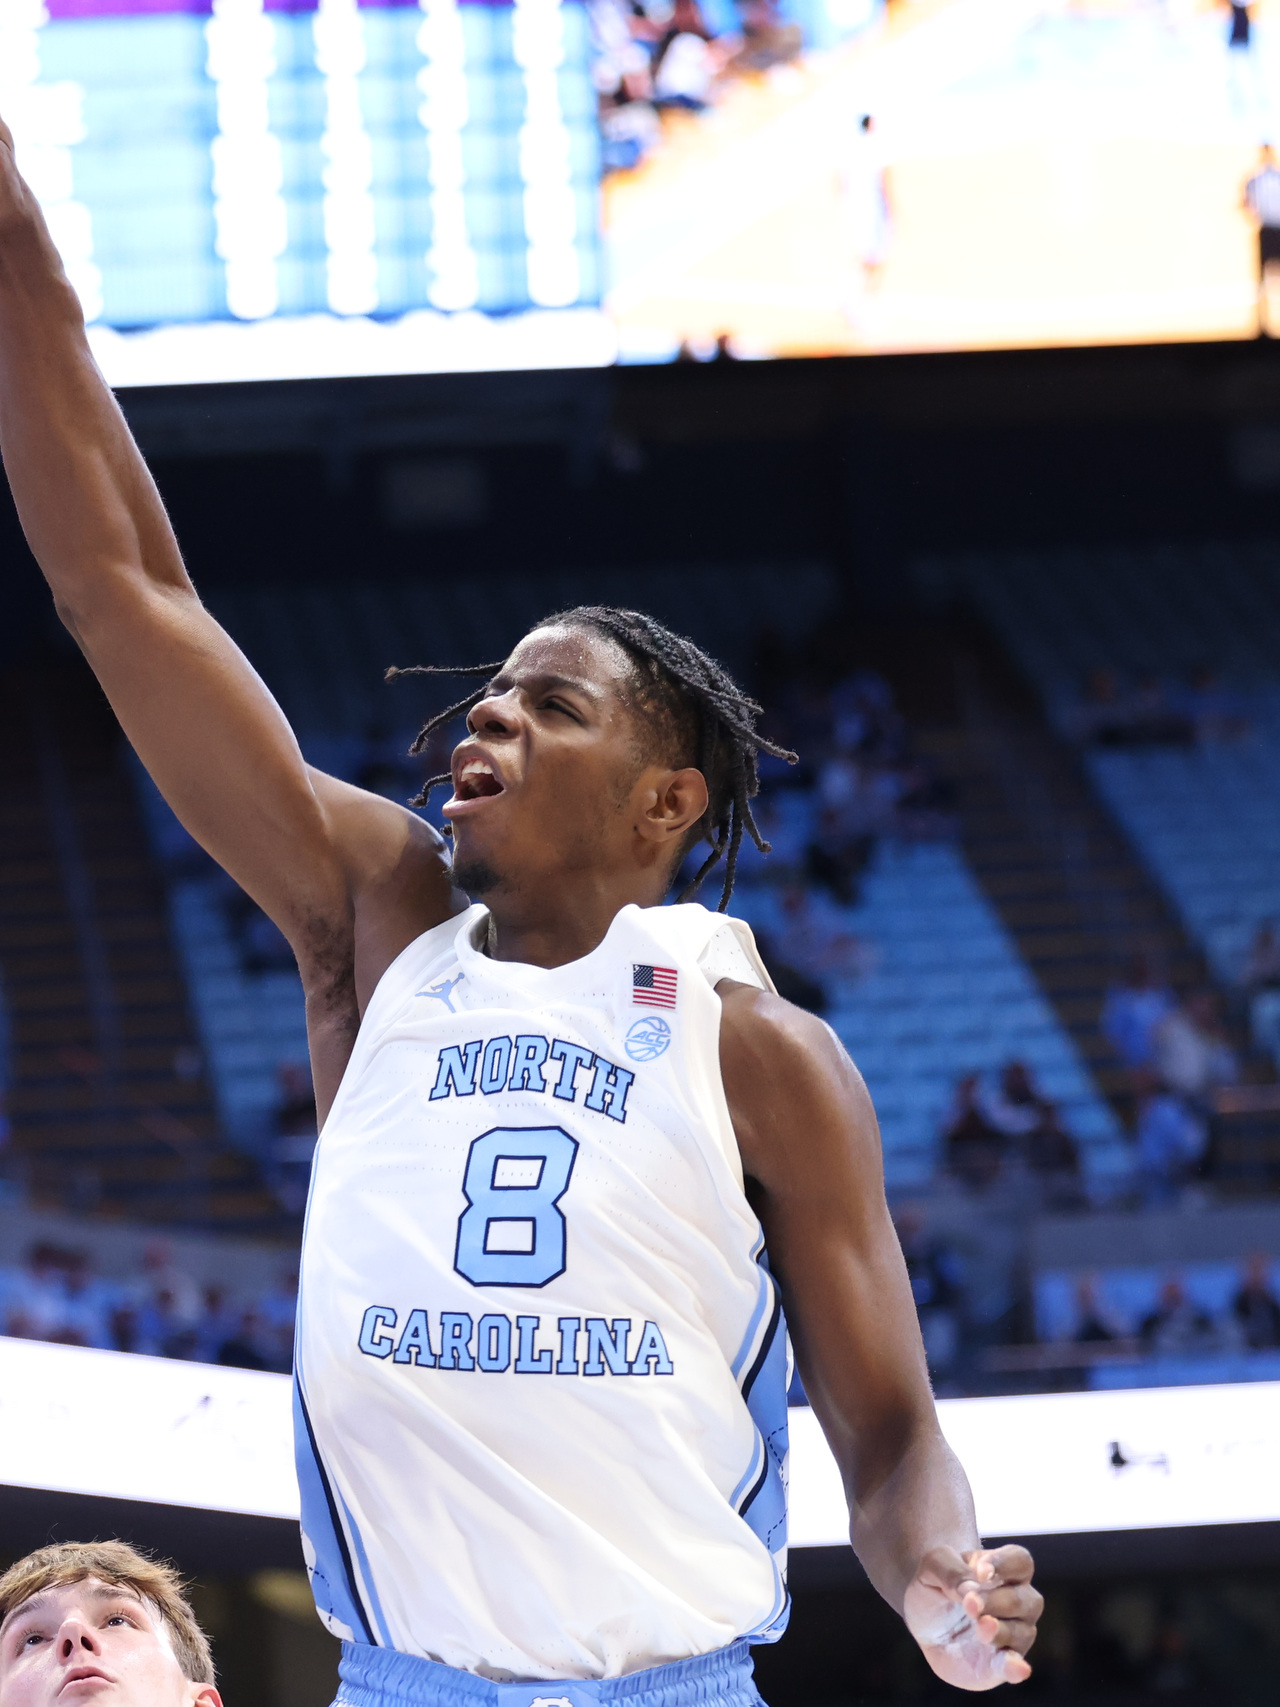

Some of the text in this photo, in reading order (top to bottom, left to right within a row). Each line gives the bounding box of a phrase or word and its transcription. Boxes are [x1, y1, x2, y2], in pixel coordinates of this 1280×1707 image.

[631, 1031, 670, 1044] ACC
[429, 1034, 635, 1124] NORTH
[454, 1126, 579, 1287] 8
[358, 1305, 674, 1376] CAROLINA
